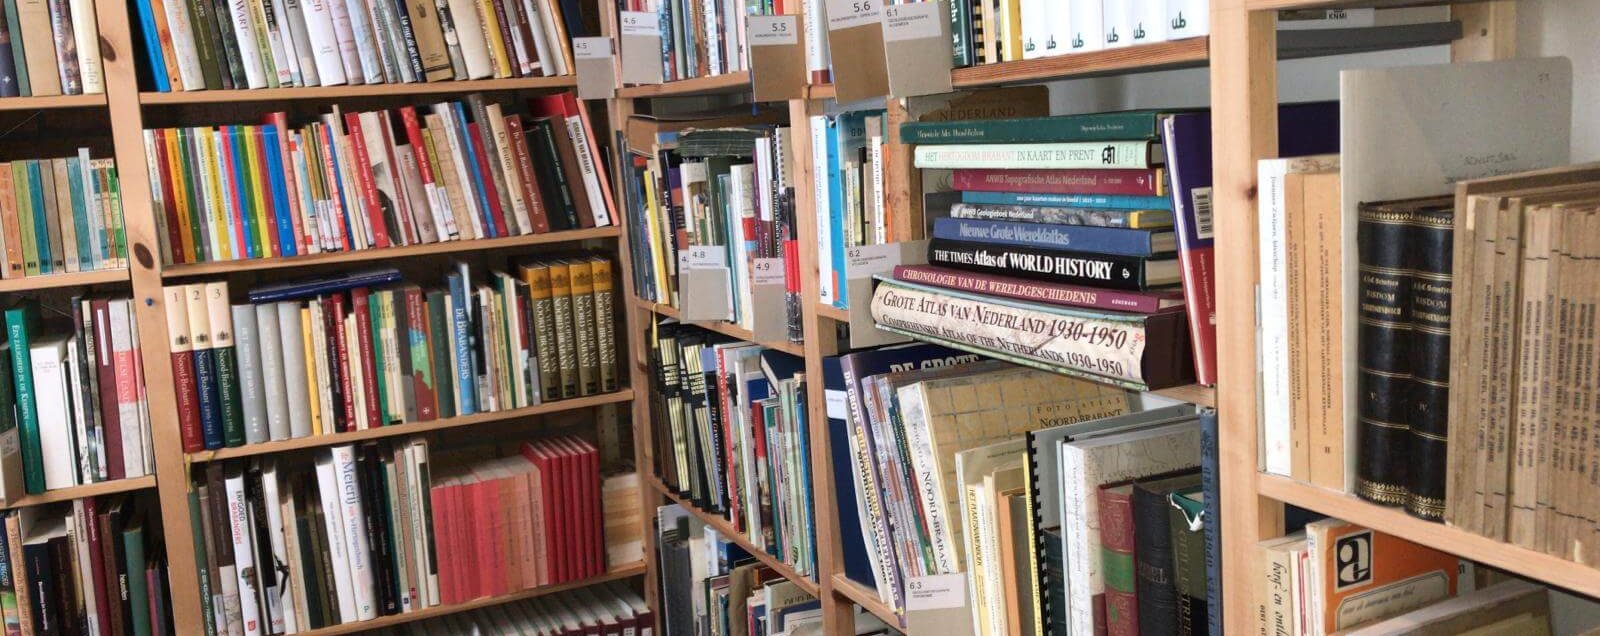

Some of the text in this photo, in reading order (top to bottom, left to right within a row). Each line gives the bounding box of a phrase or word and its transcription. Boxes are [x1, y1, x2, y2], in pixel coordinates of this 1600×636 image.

[853, 1, 871, 13] 5.6
[886, 8, 898, 17] 6.1
[771, 22, 786, 32] 5.5
[940, 107, 1016, 121] NEDERLAND
[498, 131, 507, 144] De
[925, 152, 937, 162] HET
[1017, 151, 1025, 162] IN
[1027, 150, 1053, 162] KAART
[1056, 150, 1066, 161] EN
[1068, 149, 1095, 161] PRENT
[985, 174, 1096, 186] ANWB Topografische Atlas Nederland
[1009, 209, 1034, 219] Nederland
[959, 222, 1070, 246] Nieuwe Grote Wereldatlas
[693, 251, 706, 259] 4.8
[756, 263, 770, 271] 4.9
[934, 248, 1113, 281] THE TIMES Atlas of WORLD HISTORY
[193, 290, 200, 300] 2
[214, 288, 222, 298] 3
[903, 268, 1097, 305] CHRONOLOGIE VAN DE WERELDGESCHIEDENIS
[883, 290, 1128, 350] GROTE ATLAS VAN NEDERLAND 1930-1950
[454, 307, 473, 379] DE BRABANDERS
[882, 314, 1123, 377] COMPREHENSIVE ATLAS OF THE NETHERLANDS 1930-1950
[567, 352, 575, 369] VAN
[589, 350, 597, 367] VAN
[176, 352, 192, 405] Noord-Brabant
[197, 351, 210, 402] Noord-Brabant
[217, 348, 232, 400] Noord-Brabant
[842, 370, 853, 385] DE
[20, 392, 31, 419] KEMPEN
[845, 387, 861, 423] GROTE
[1036, 404, 1071, 415] FOTO
[1040, 408, 1123, 429] NOORD-BRABANT
[340, 461, 360, 505] Meierij
[917, 470, 955, 575] NOORD-BRABANT
[968, 503, 985, 566] PLAATSNAMENBOEK
[117, 573, 130, 601] heusden
[909, 581, 922, 590] 6.3
[1273, 592, 1282, 605] en
